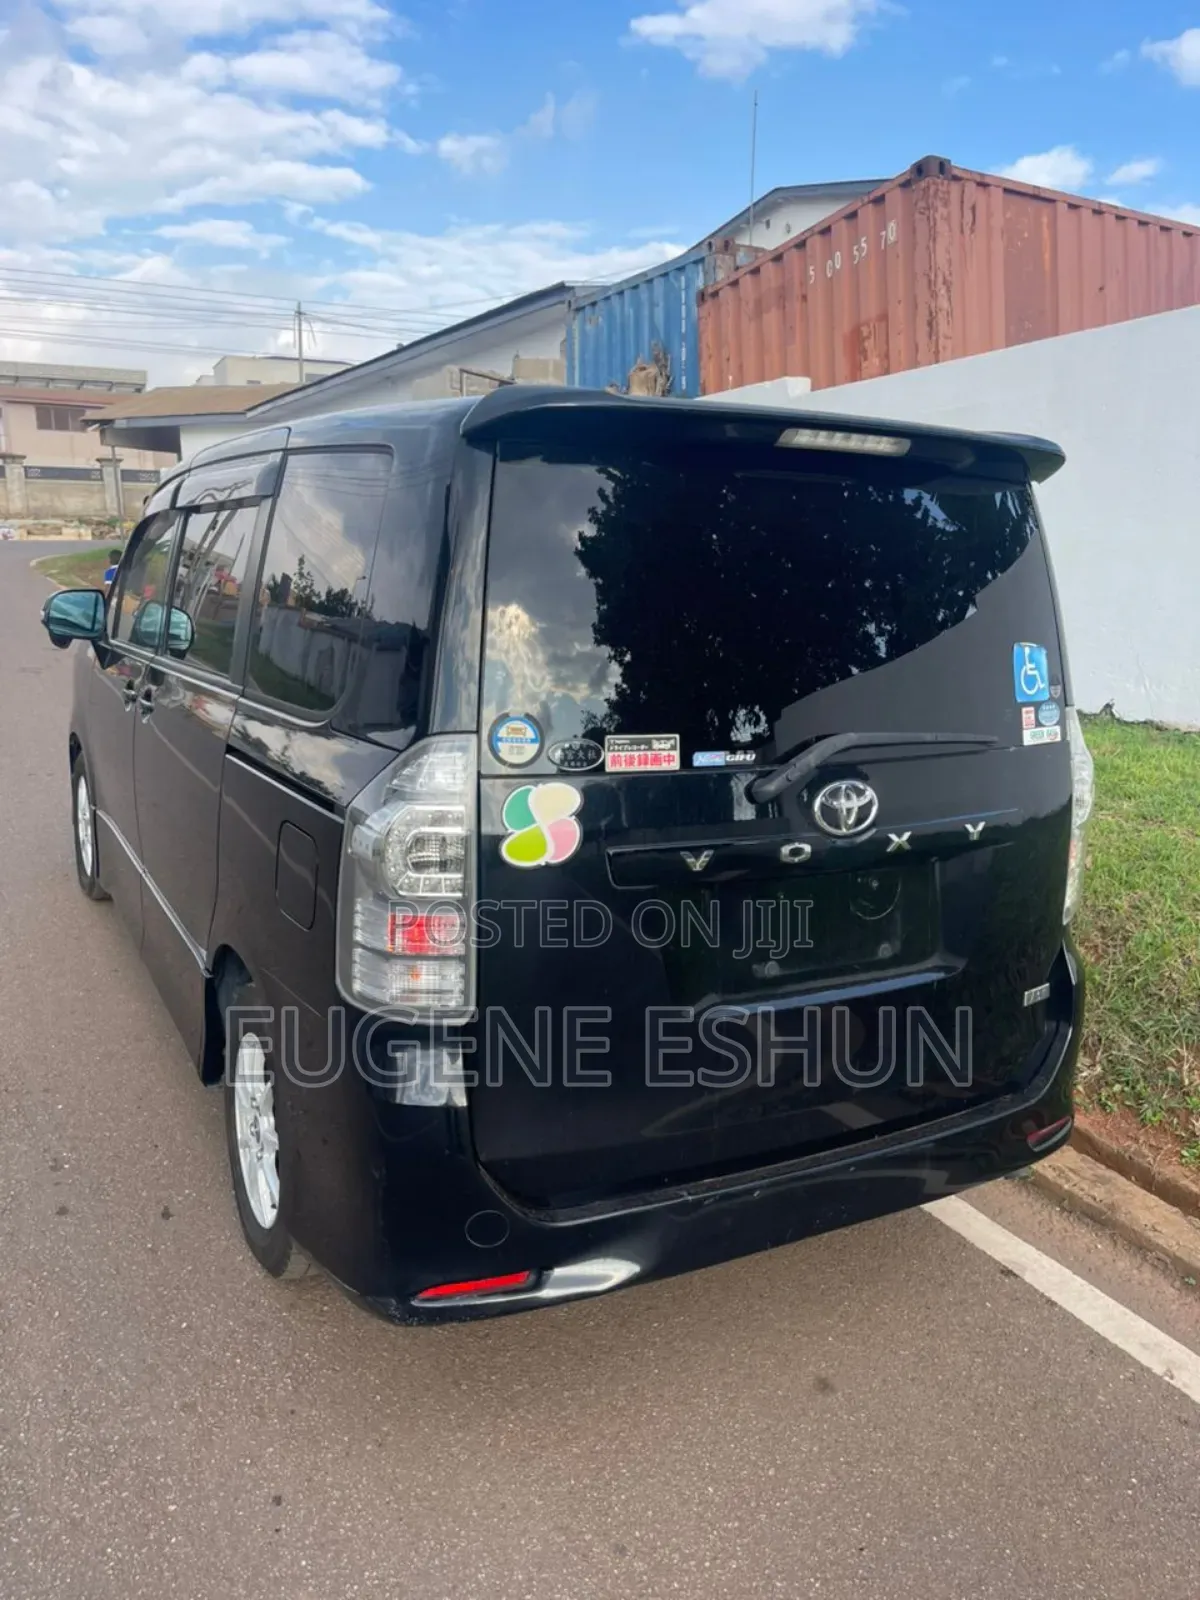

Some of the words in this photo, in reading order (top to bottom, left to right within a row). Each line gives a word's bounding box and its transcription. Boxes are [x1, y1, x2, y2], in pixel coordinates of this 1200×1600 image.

[609, 752, 676, 768] 前後録画中
